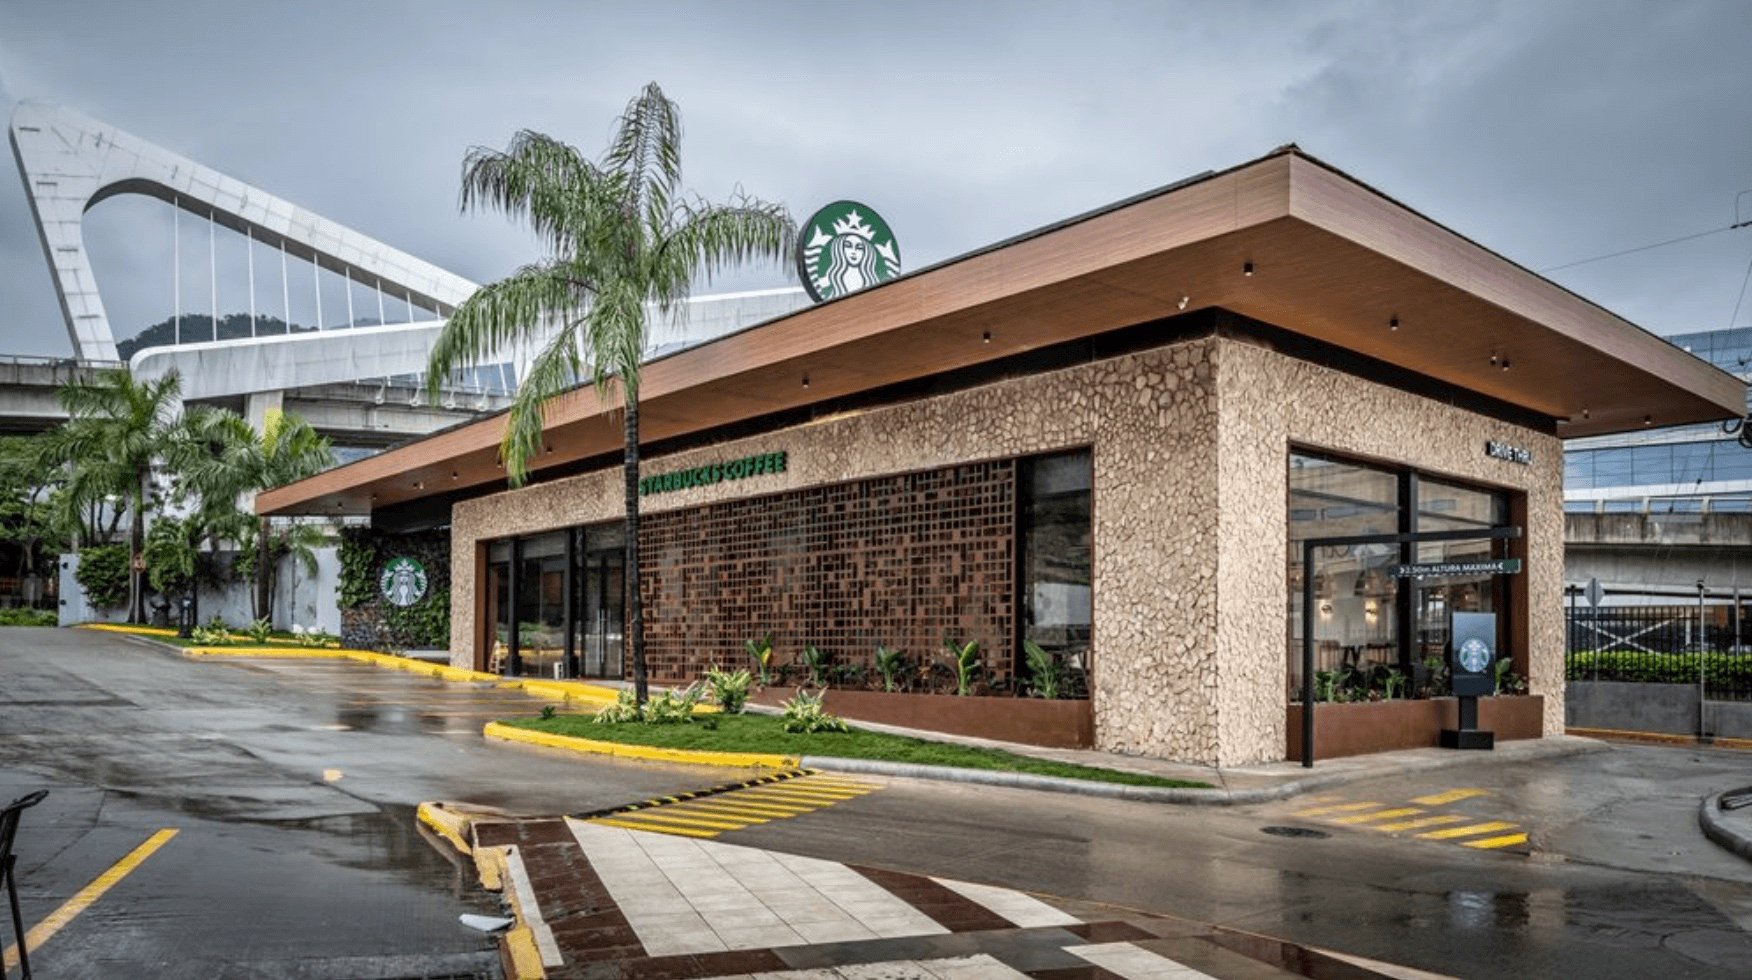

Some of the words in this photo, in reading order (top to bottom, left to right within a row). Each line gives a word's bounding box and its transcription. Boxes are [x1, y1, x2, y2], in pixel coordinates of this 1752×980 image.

[639, 463, 723, 496] STARBUCKS
[723, 451, 786, 480] COFFEE
[1431, 563, 1461, 573] ALTURA
